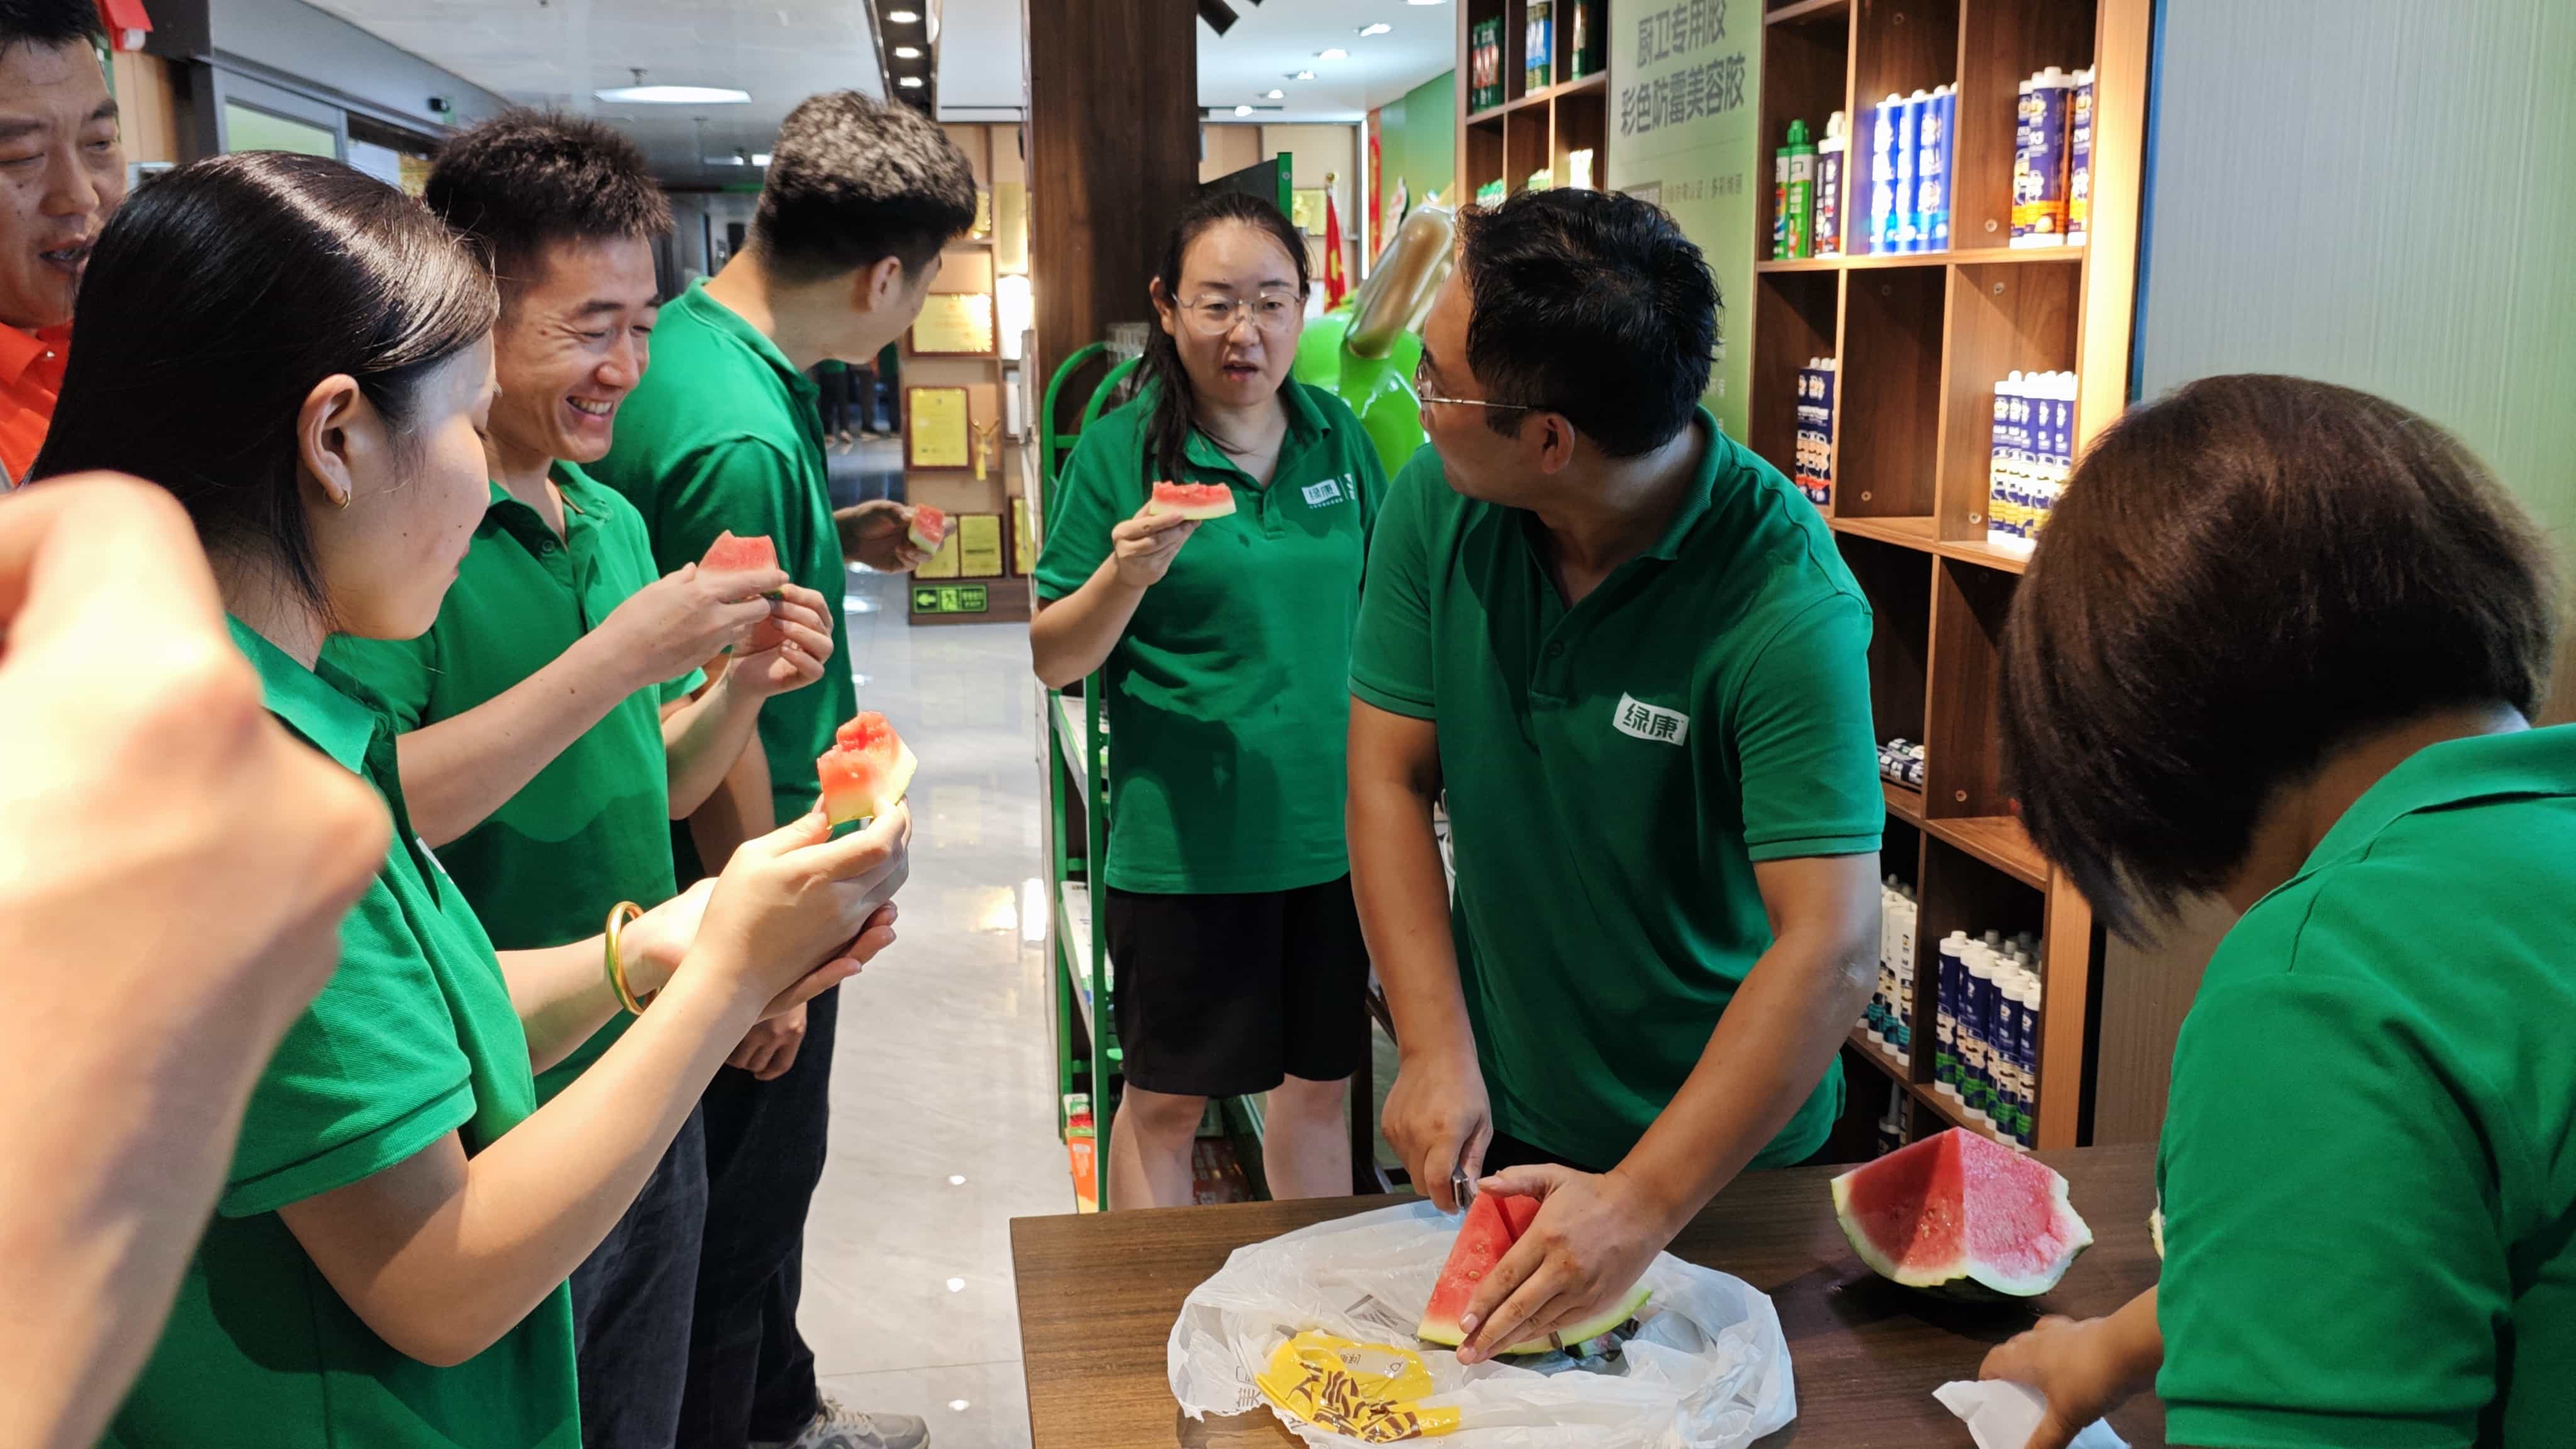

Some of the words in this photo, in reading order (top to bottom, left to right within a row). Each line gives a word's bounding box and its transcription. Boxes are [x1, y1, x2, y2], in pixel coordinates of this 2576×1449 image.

[1637, 0, 1726, 70] 厨卫专用胶
[1620, 51, 1745, 138] 彩色防霉美容胶
[1623, 703, 1679, 740] 绿康
